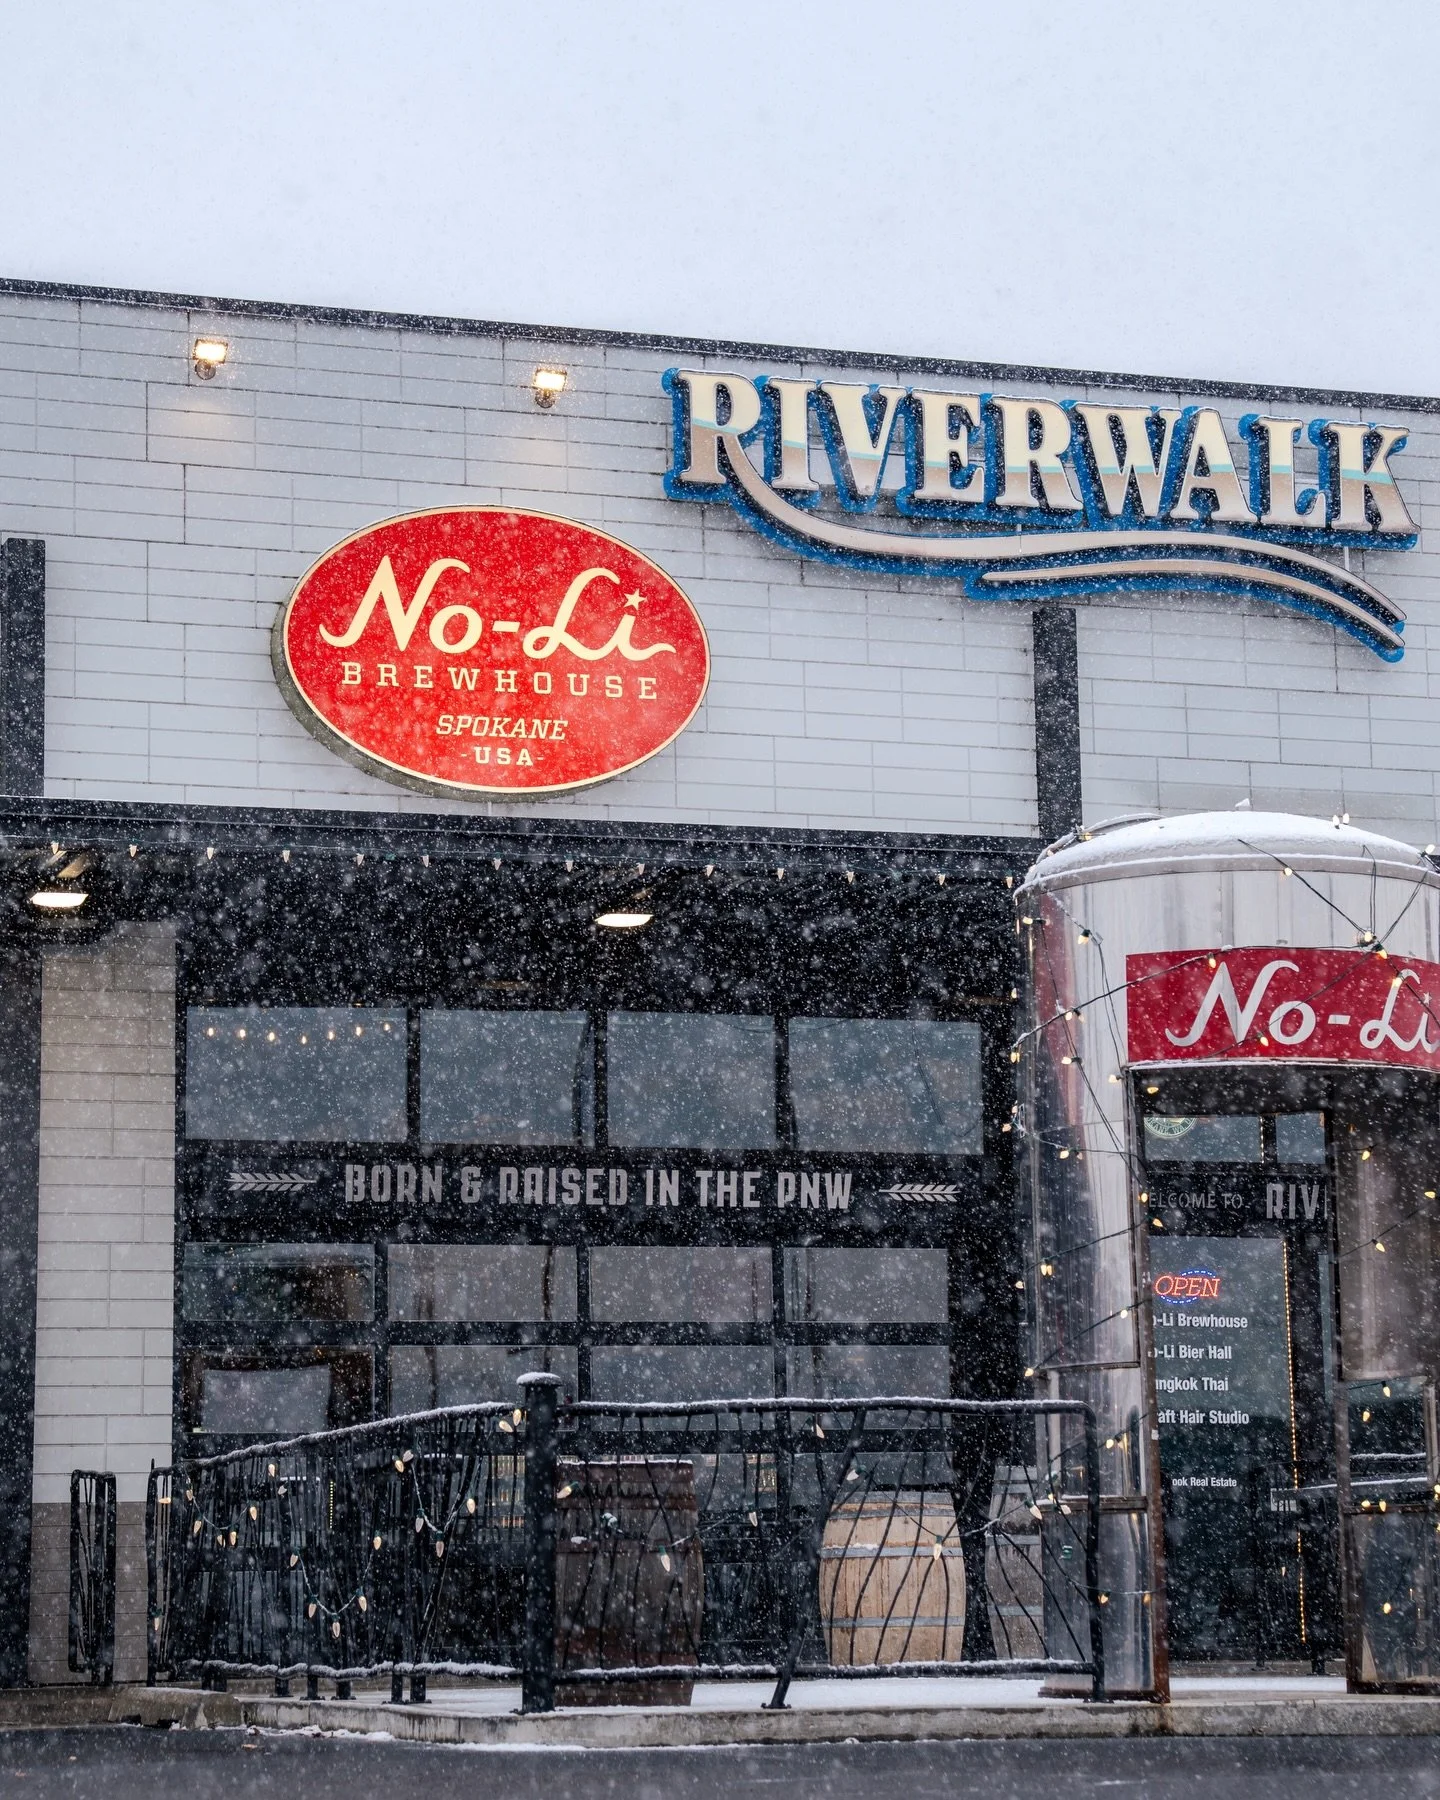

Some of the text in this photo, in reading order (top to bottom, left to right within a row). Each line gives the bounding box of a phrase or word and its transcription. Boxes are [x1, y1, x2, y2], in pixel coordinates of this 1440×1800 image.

[671, 367, 1421, 542] RIVERWALK
[319, 555, 677, 662] No-Li
[341, 661, 658, 700] BREWHOUSE
[436, 714, 569, 741] SPOKANE
[1164, 959, 1440, 1054] No-Li
[345, 1164, 853, 1210] BORN & RAISED IN THE PNW
[1148, 1183, 1328, 1220] ELCOME TO RIV
[1155, 1275, 1221, 1297] OPEN
[1177, 1313, 1248, 1328] Brewhouse
[1153, 1344, 1232, 1360] -Li Bier Hall
[1201, 1376, 1229, 1391] Thai
[1157, 1409, 1250, 1425] aft Hair Studio
[1172, 1476, 1237, 1488] ook Real Estate
